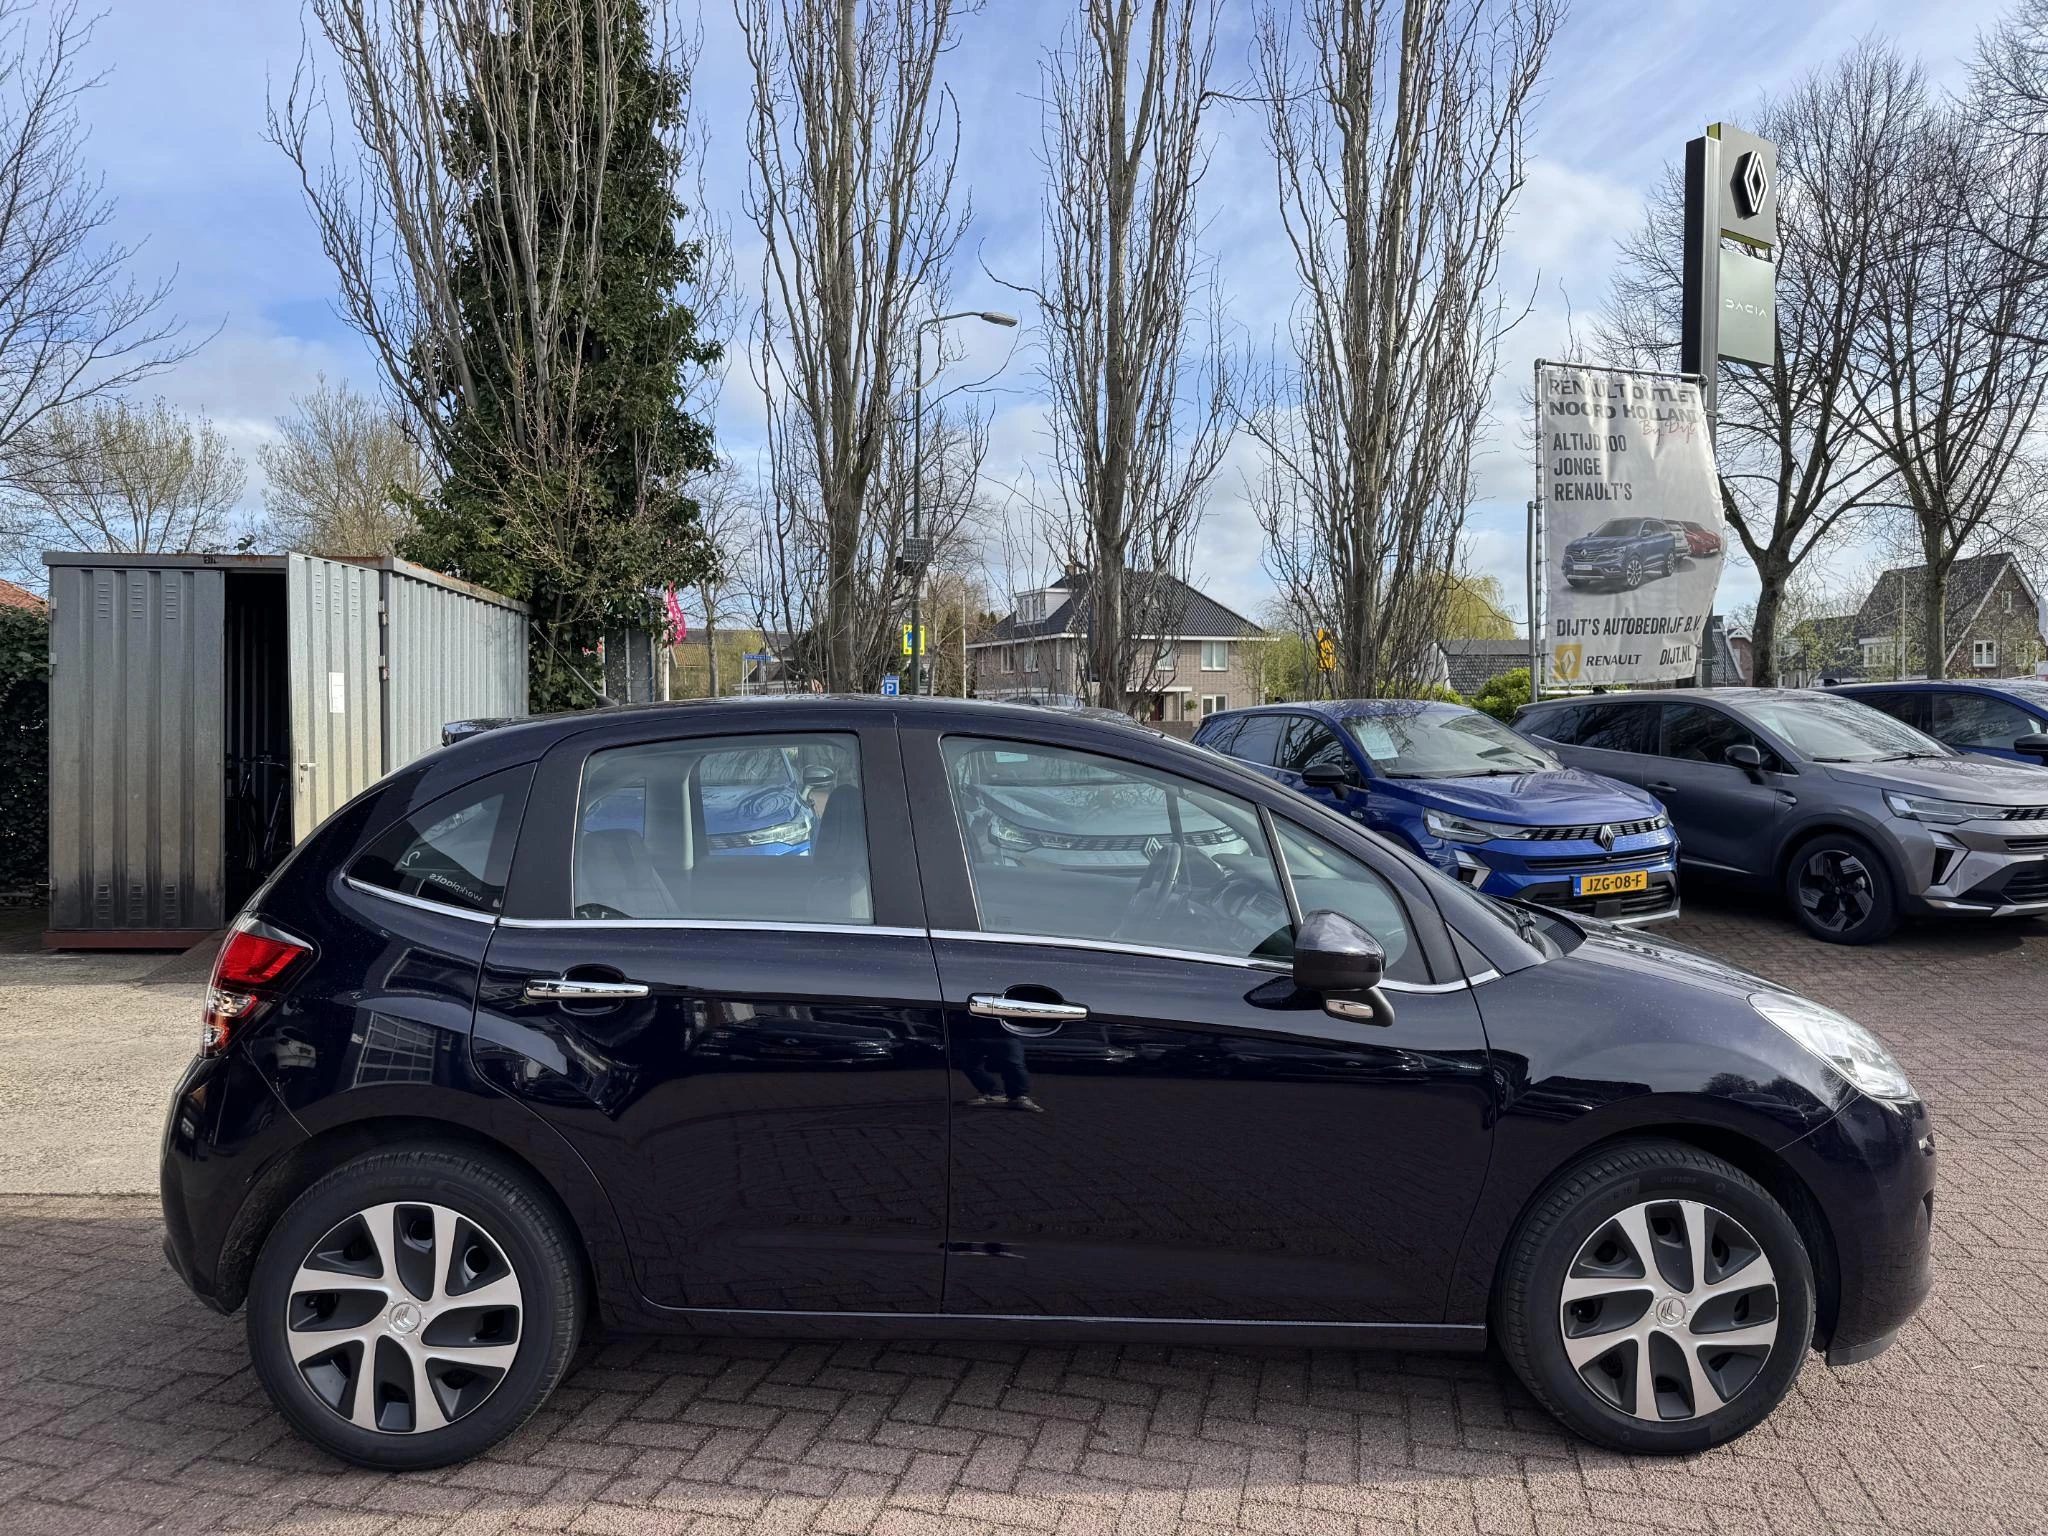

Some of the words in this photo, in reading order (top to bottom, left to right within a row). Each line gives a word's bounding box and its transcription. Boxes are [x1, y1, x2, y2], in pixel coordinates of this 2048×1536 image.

[1726, 299, 1767, 318] DACIA
[1553, 432, 1601, 451] ALTIJD
[1639, 419, 1664, 446] By
[1554, 457, 1602, 476] JONGE
[1554, 482, 1633, 502] RENAULT'S
[1556, 618, 1600, 637] DIJT'S
[1603, 616, 1684, 635] AUTOBEDRIJF
[1684, 615, 1702, 632] B.V.
[1585, 654, 1642, 667] RENAULT
[1659, 645, 1692, 665] DIJT.NL
[886, 683, 894, 695] P
[1586, 874, 1643, 892] JZG-08-F
